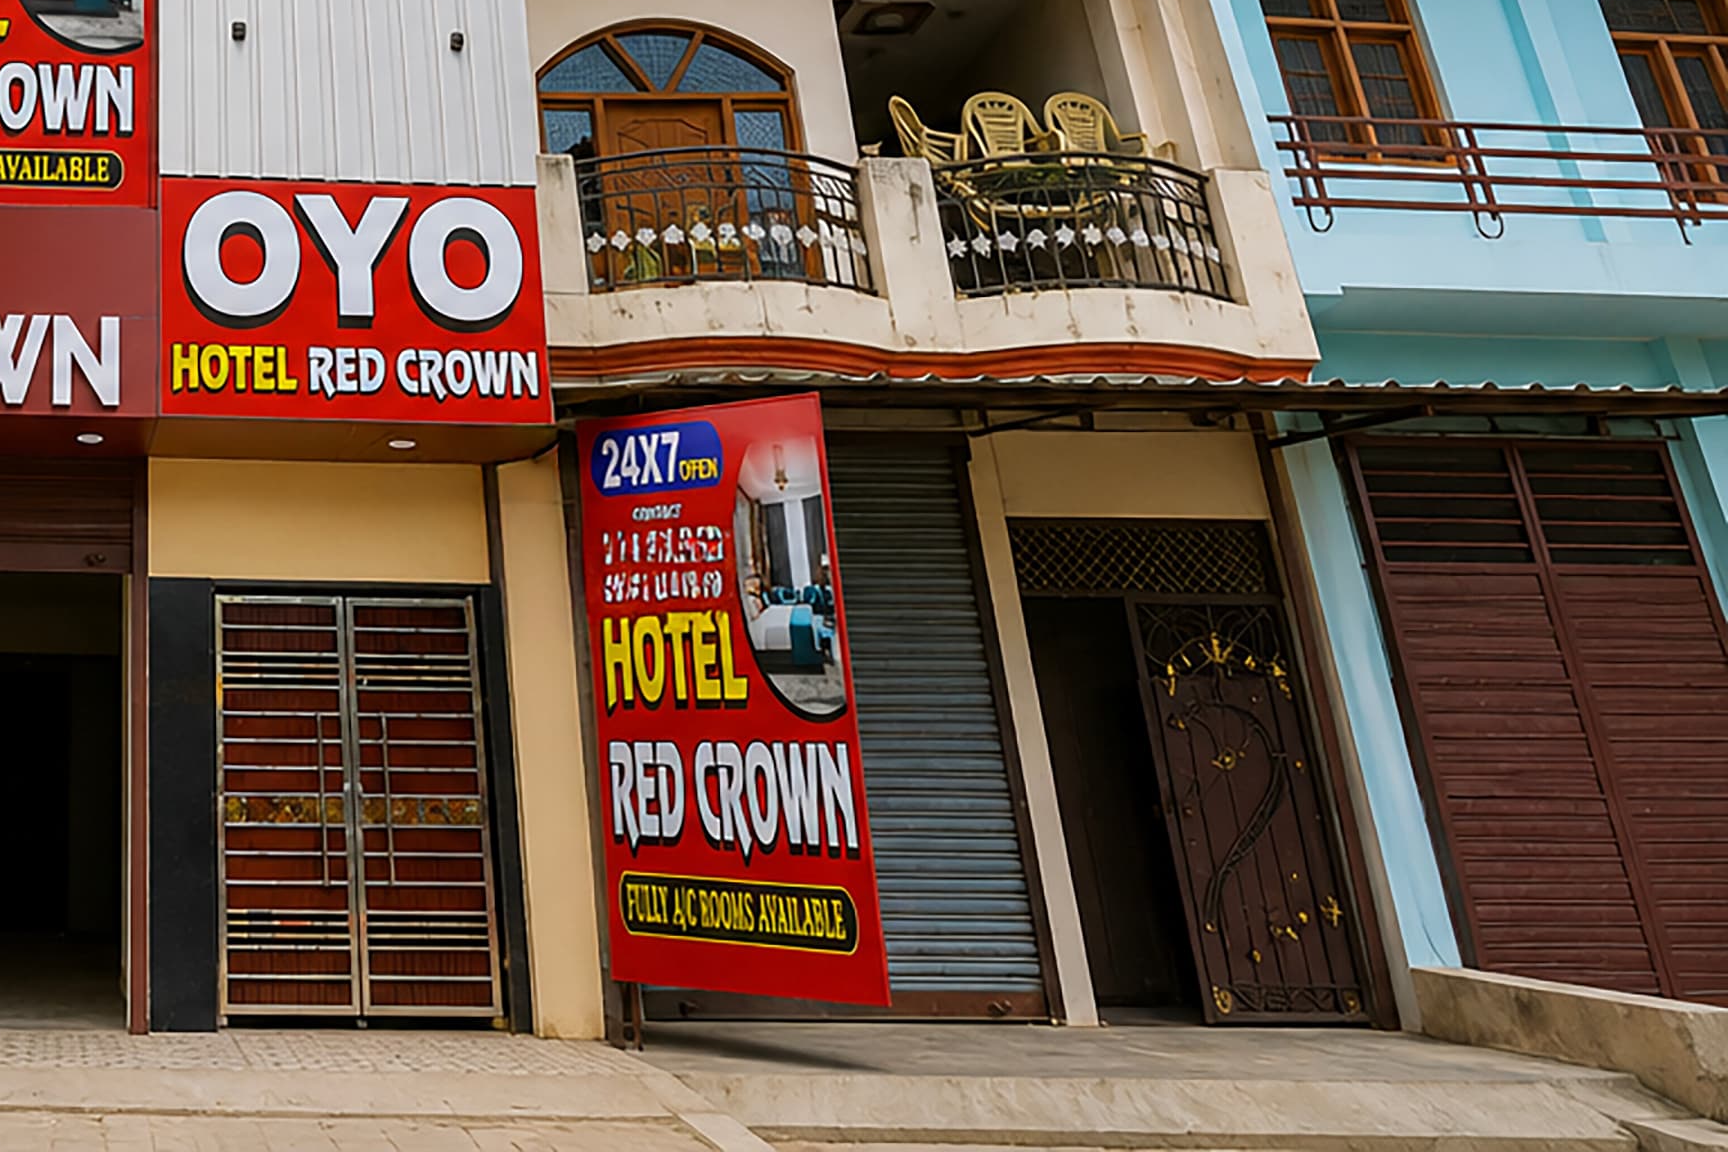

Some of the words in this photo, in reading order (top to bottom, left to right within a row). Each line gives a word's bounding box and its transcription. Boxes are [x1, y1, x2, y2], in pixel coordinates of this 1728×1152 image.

[182, 189, 524, 334] OYO
[172, 343, 298, 395] HOTEL
[308, 346, 387, 400] RED
[395, 348, 540, 402] CROWN
[601, 431, 680, 489] 24X7
[603, 611, 748, 716] HOTEL
[608, 741, 686, 856] RED
[694, 741, 860, 864] CROWN
[626, 883, 669, 924] FULLY
[700, 890, 755, 933] ROOMS
[758, 894, 848, 940] AVAILABLE
